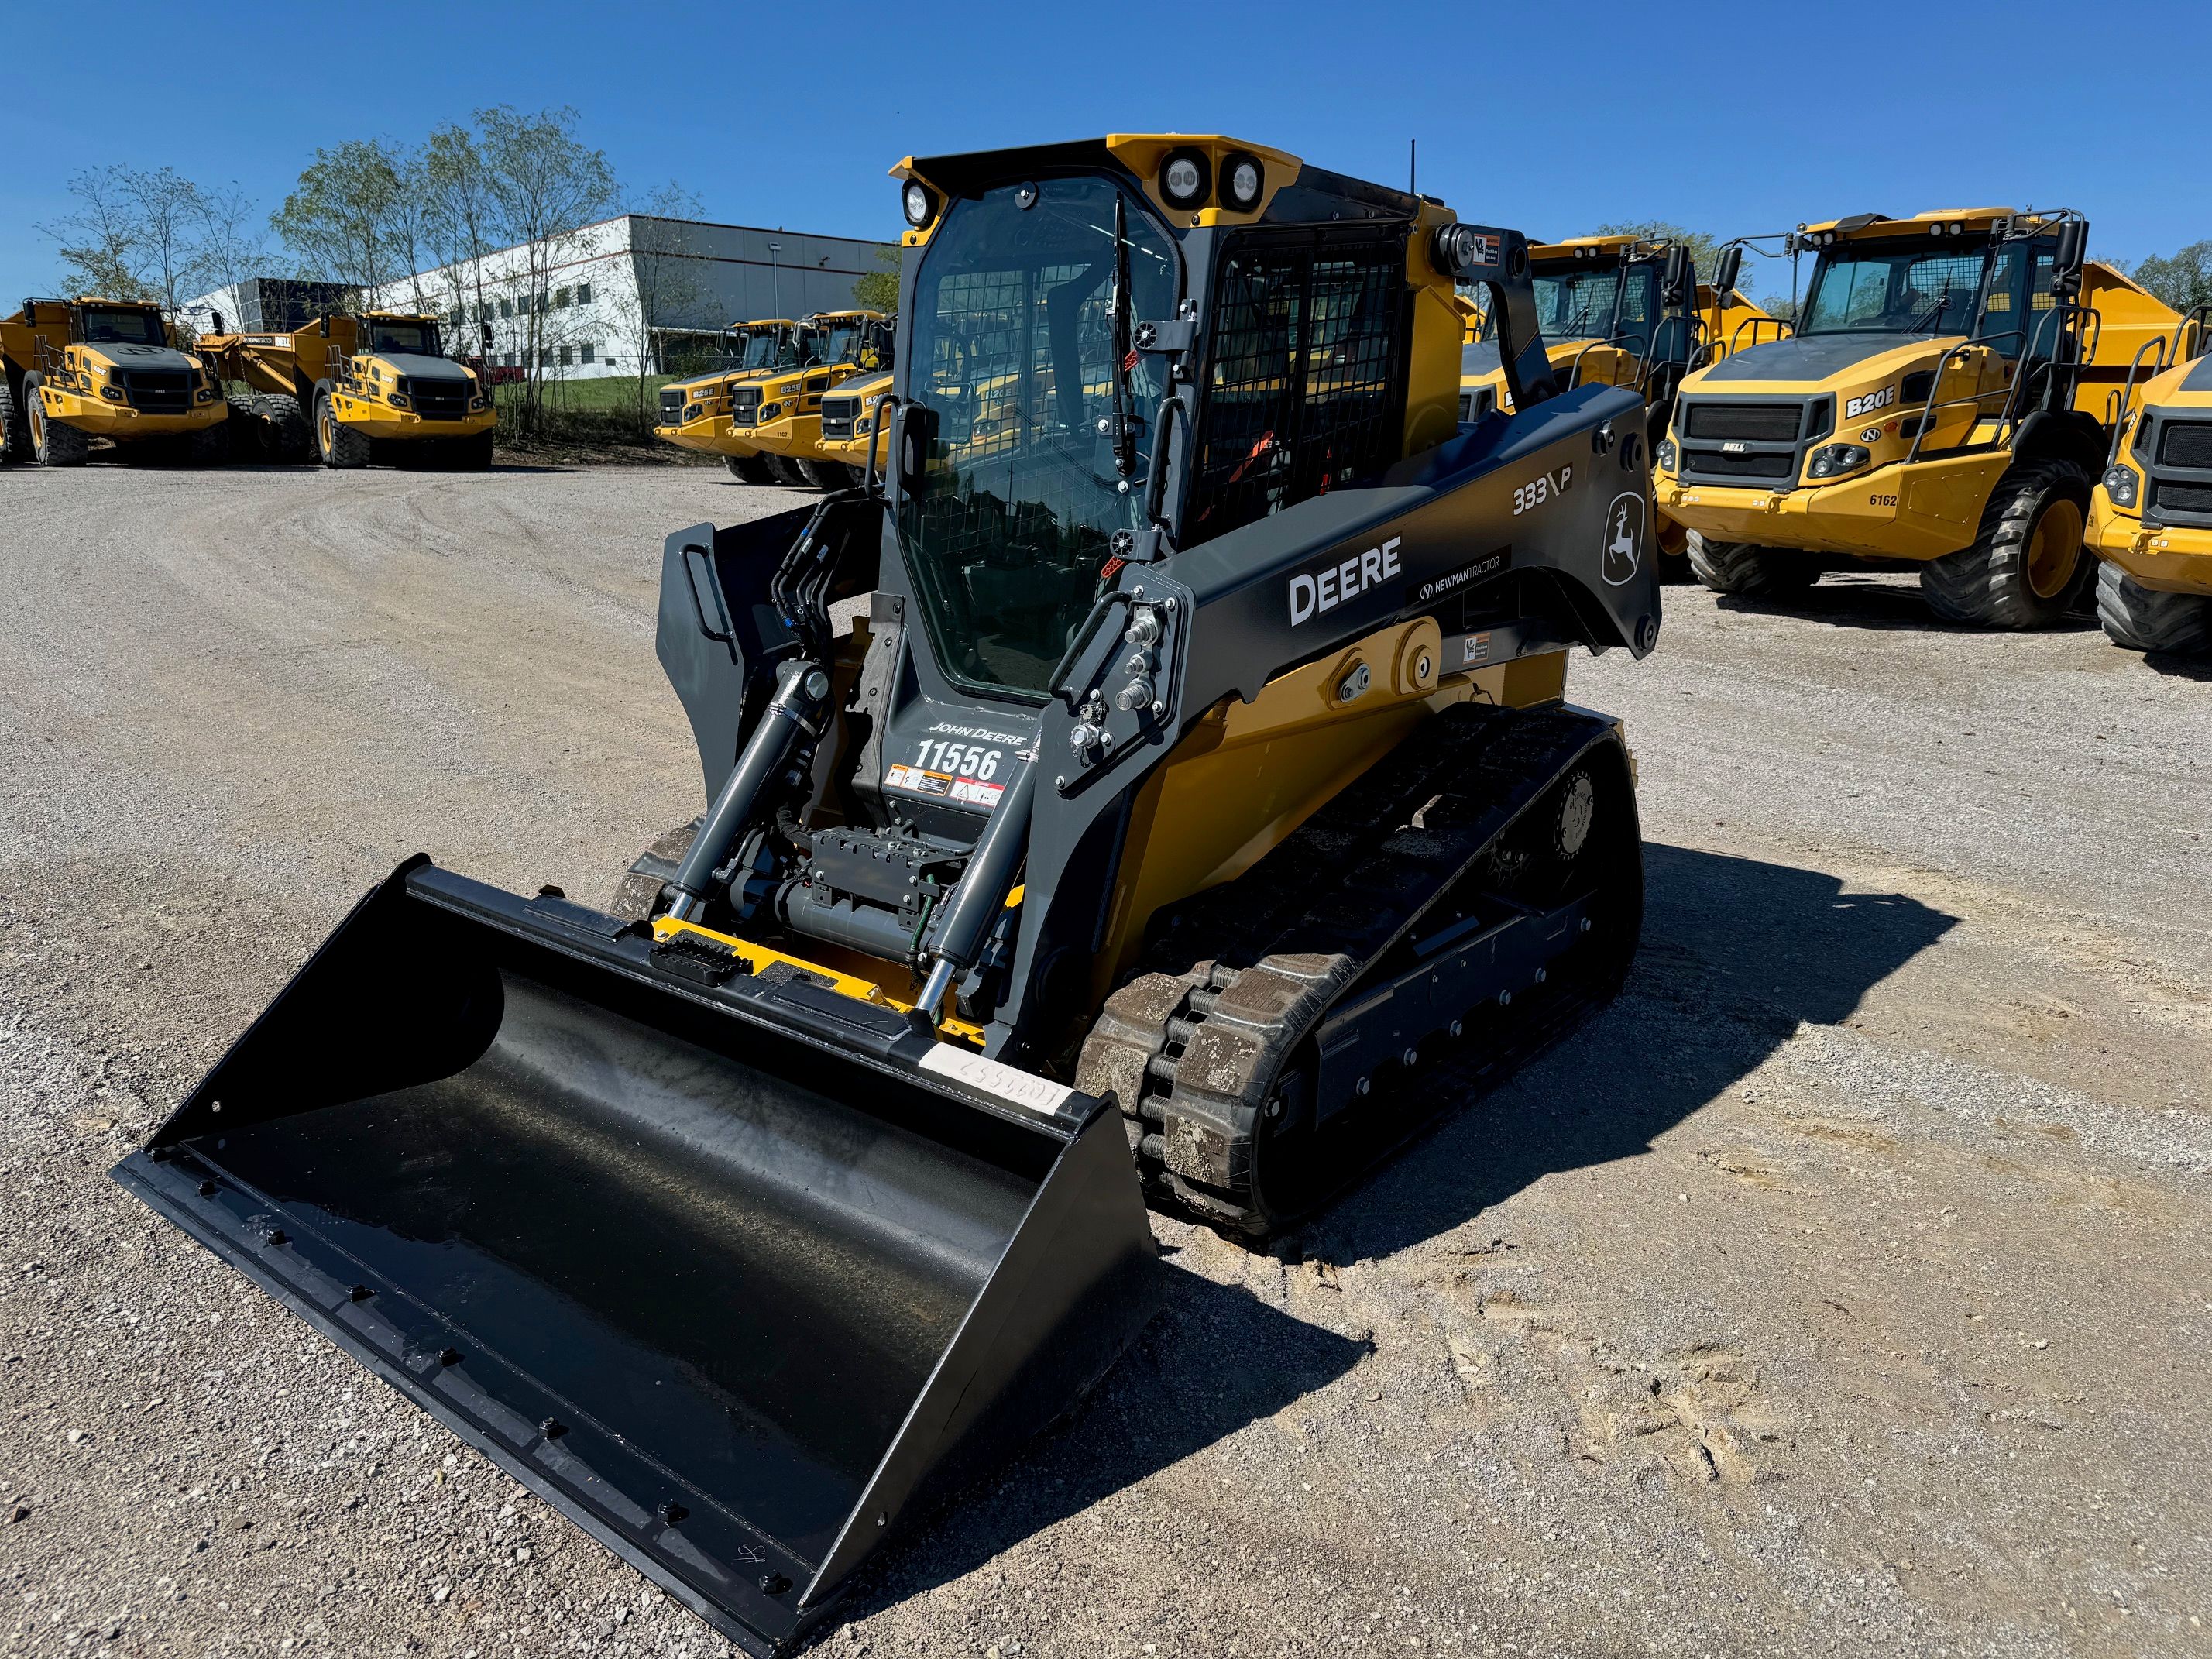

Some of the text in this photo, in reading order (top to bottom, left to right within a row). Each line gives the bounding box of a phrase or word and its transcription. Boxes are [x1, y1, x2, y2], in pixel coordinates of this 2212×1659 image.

[276, 336, 290, 348] BELL
[692, 388, 715, 399] B25E
[1846, 384, 1895, 419] B20E
[1723, 442, 1745, 452] BELL
[1870, 494, 1898, 506] 6162
[1289, 536, 1401, 627] DEERE
[1435, 555, 1500, 594] NEWMANTRACTOR
[929, 721, 1027, 746] JOHN DEERE
[915, 738, 1002, 781] 11556
